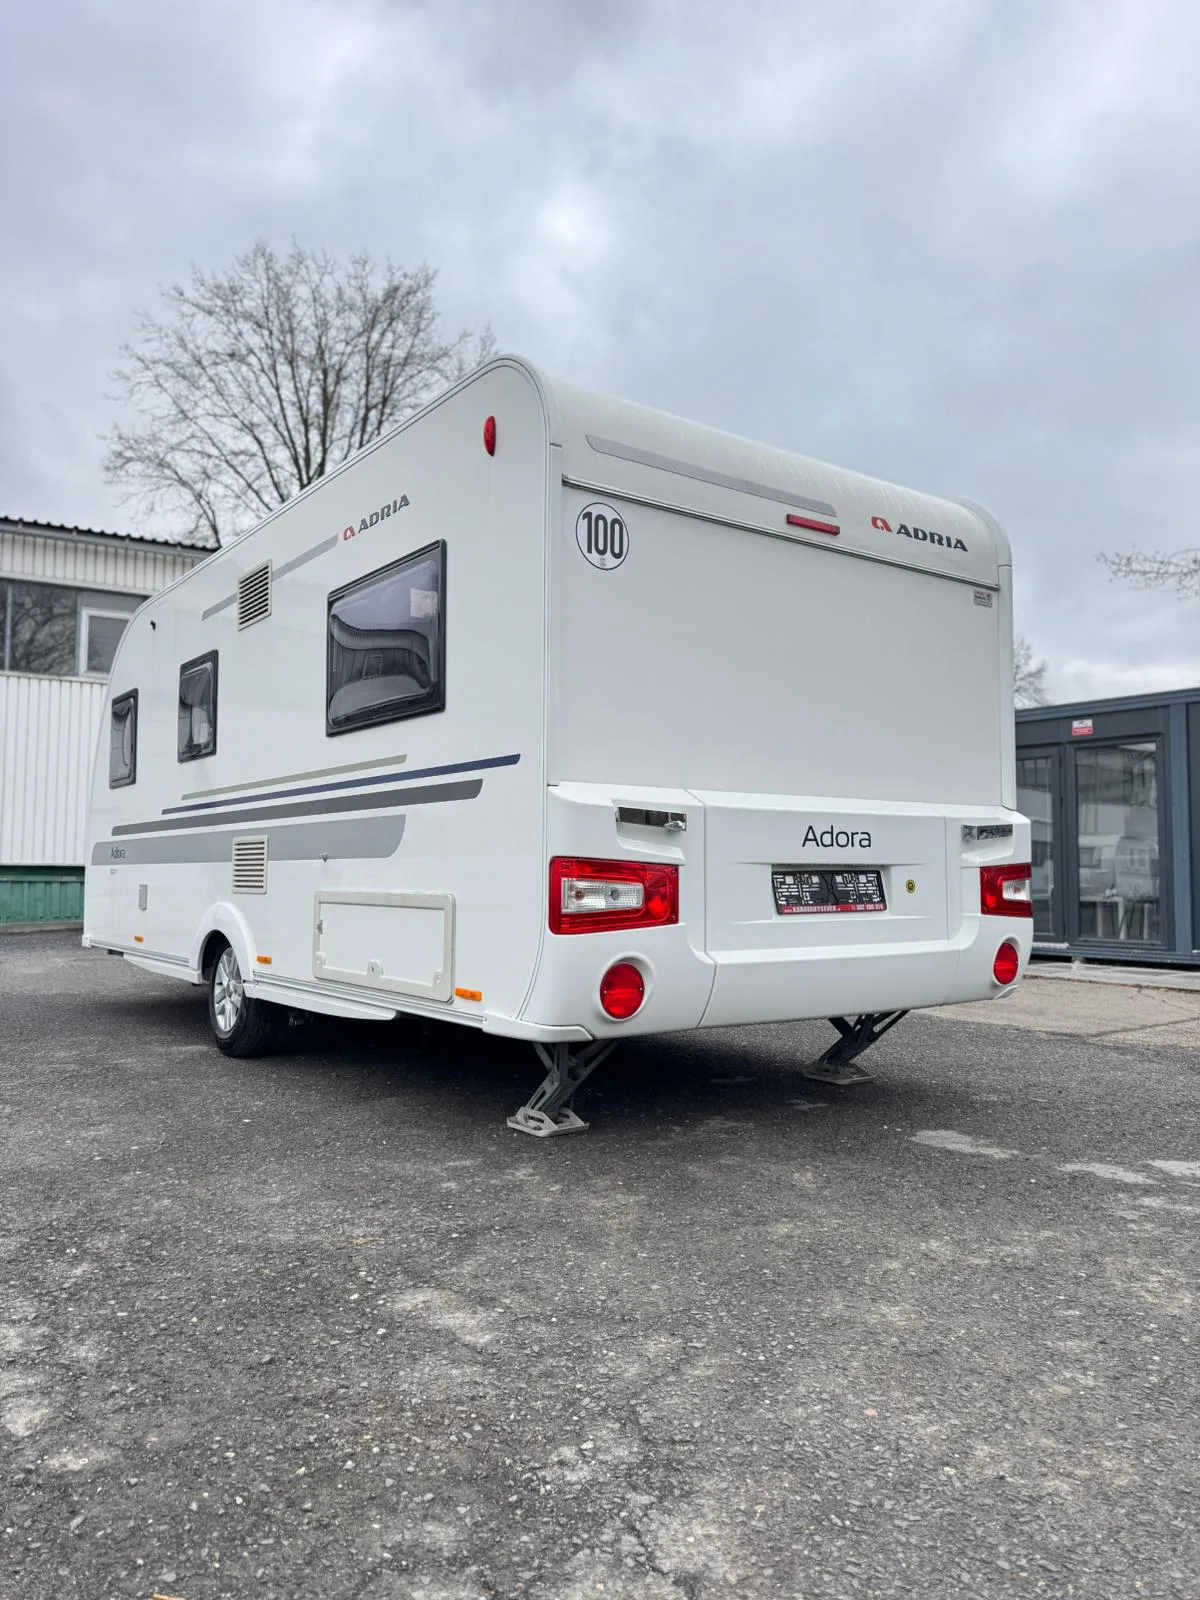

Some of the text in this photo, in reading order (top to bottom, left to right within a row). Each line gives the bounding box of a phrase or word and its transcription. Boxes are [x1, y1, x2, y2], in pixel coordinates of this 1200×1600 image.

[358, 493, 411, 534] ADRIA
[582, 511, 624, 560] 100
[896, 522, 969, 552] ADRIA
[802, 824, 872, 848] Adora
